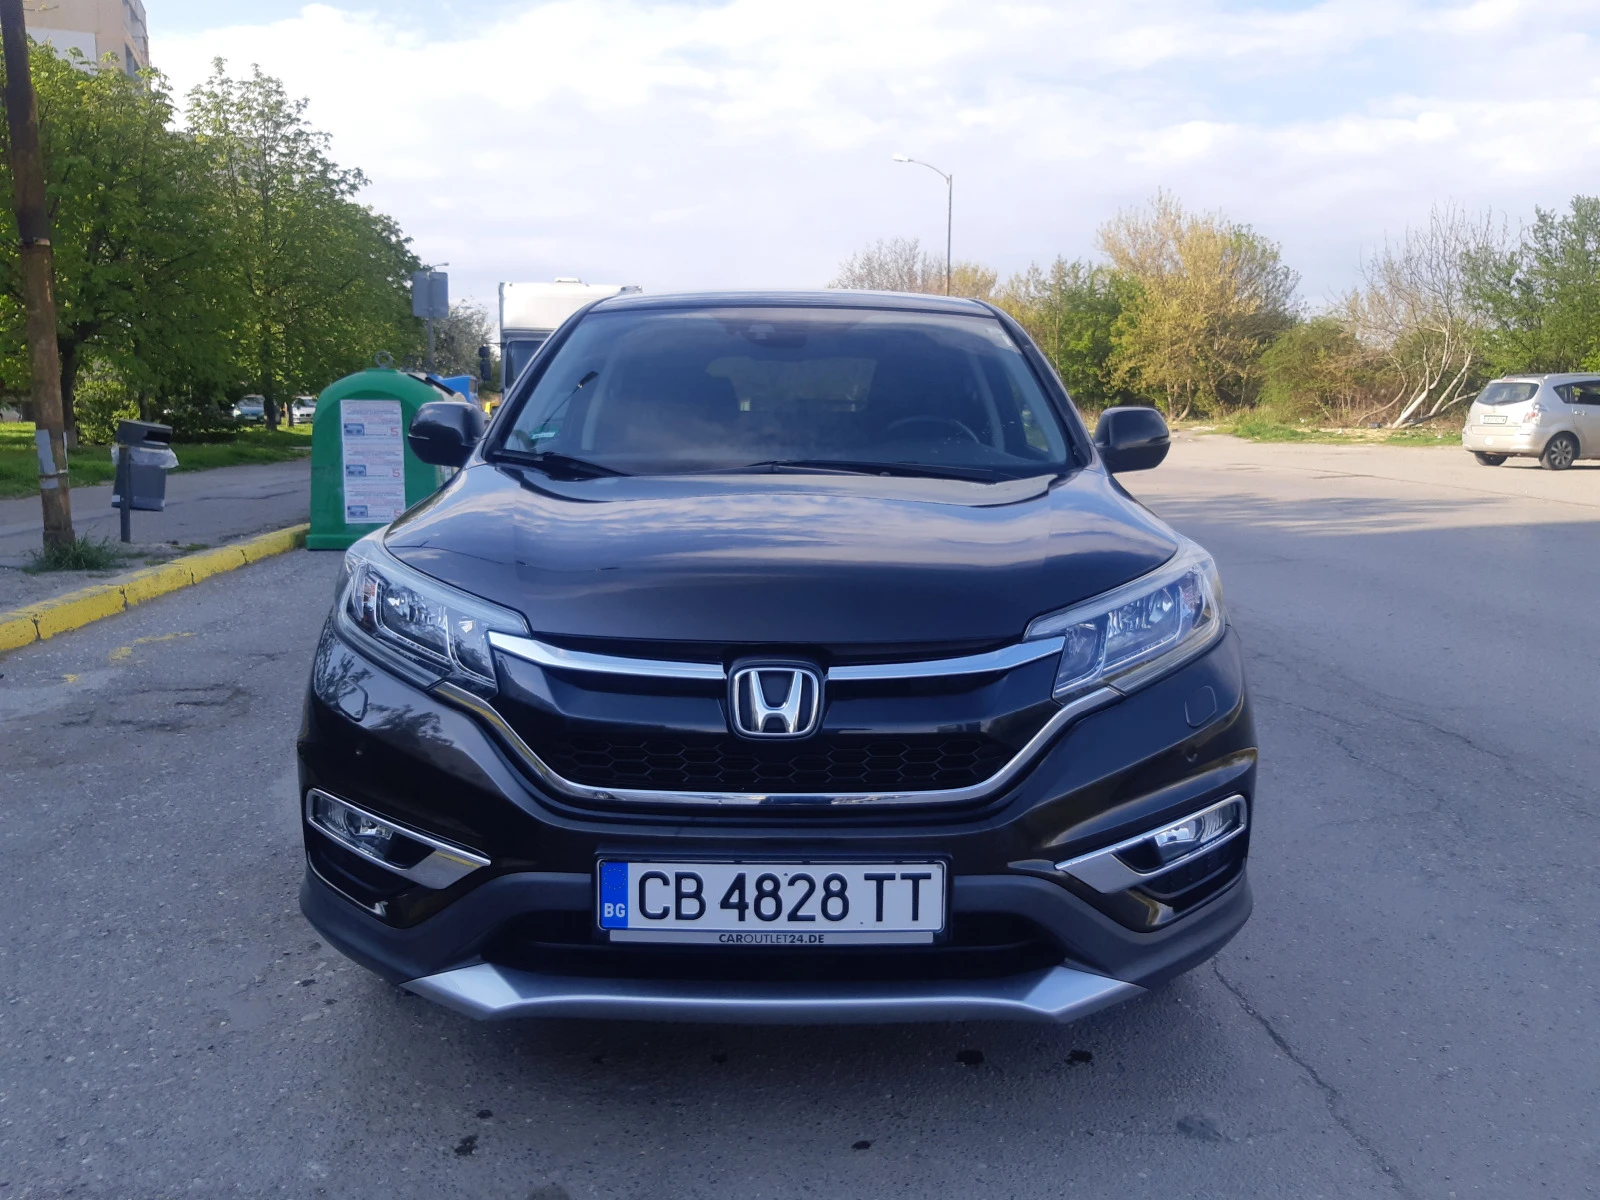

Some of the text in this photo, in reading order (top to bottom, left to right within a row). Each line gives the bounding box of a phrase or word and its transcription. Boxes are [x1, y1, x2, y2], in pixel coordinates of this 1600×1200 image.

[638, 870, 932, 923] CB 4828 TT
[603, 902, 626, 919] BG
[718, 933, 825, 945] CAROUTLET24.DE
